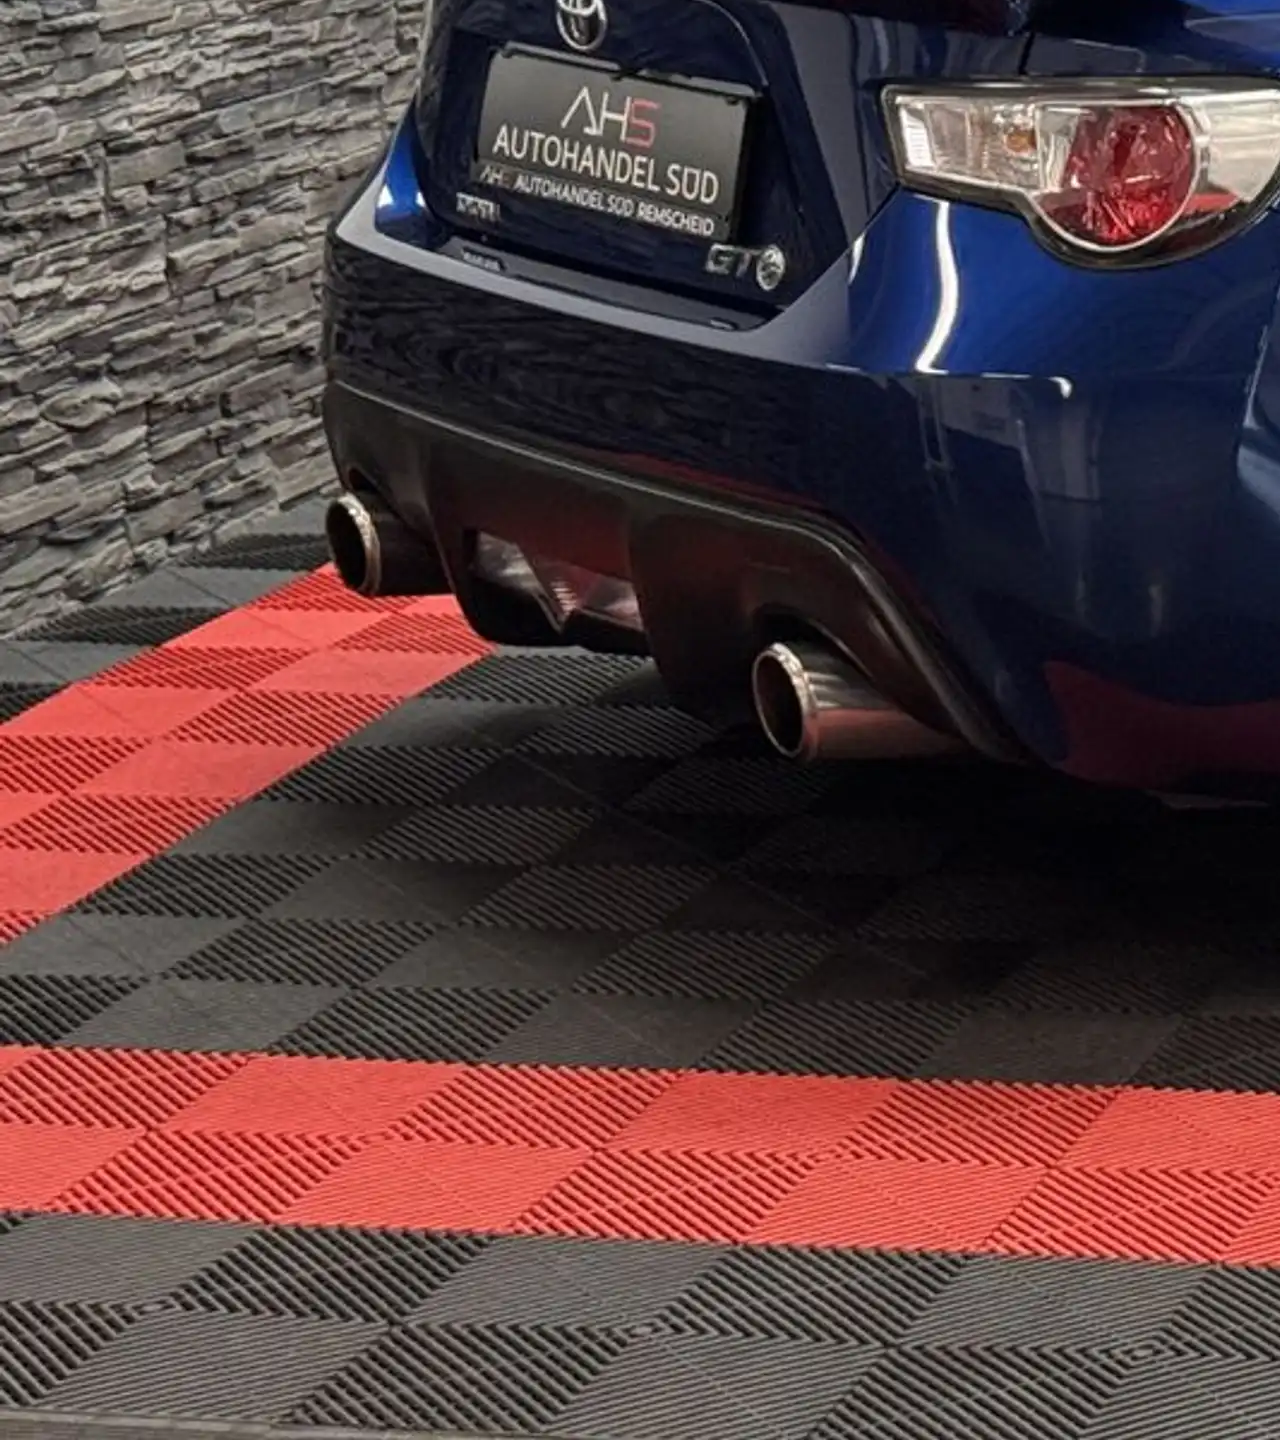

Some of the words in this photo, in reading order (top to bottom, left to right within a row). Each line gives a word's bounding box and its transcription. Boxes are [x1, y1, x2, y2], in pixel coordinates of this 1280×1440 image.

[560, 86, 662, 150] AHS
[492, 124, 661, 192] AUTOHANDEL
[665, 163, 719, 204] SÜD
[512, 174, 605, 211] AUTOHANDEL
[607, 192, 635, 218] SÜD
[636, 201, 715, 237] REMSCHEID
